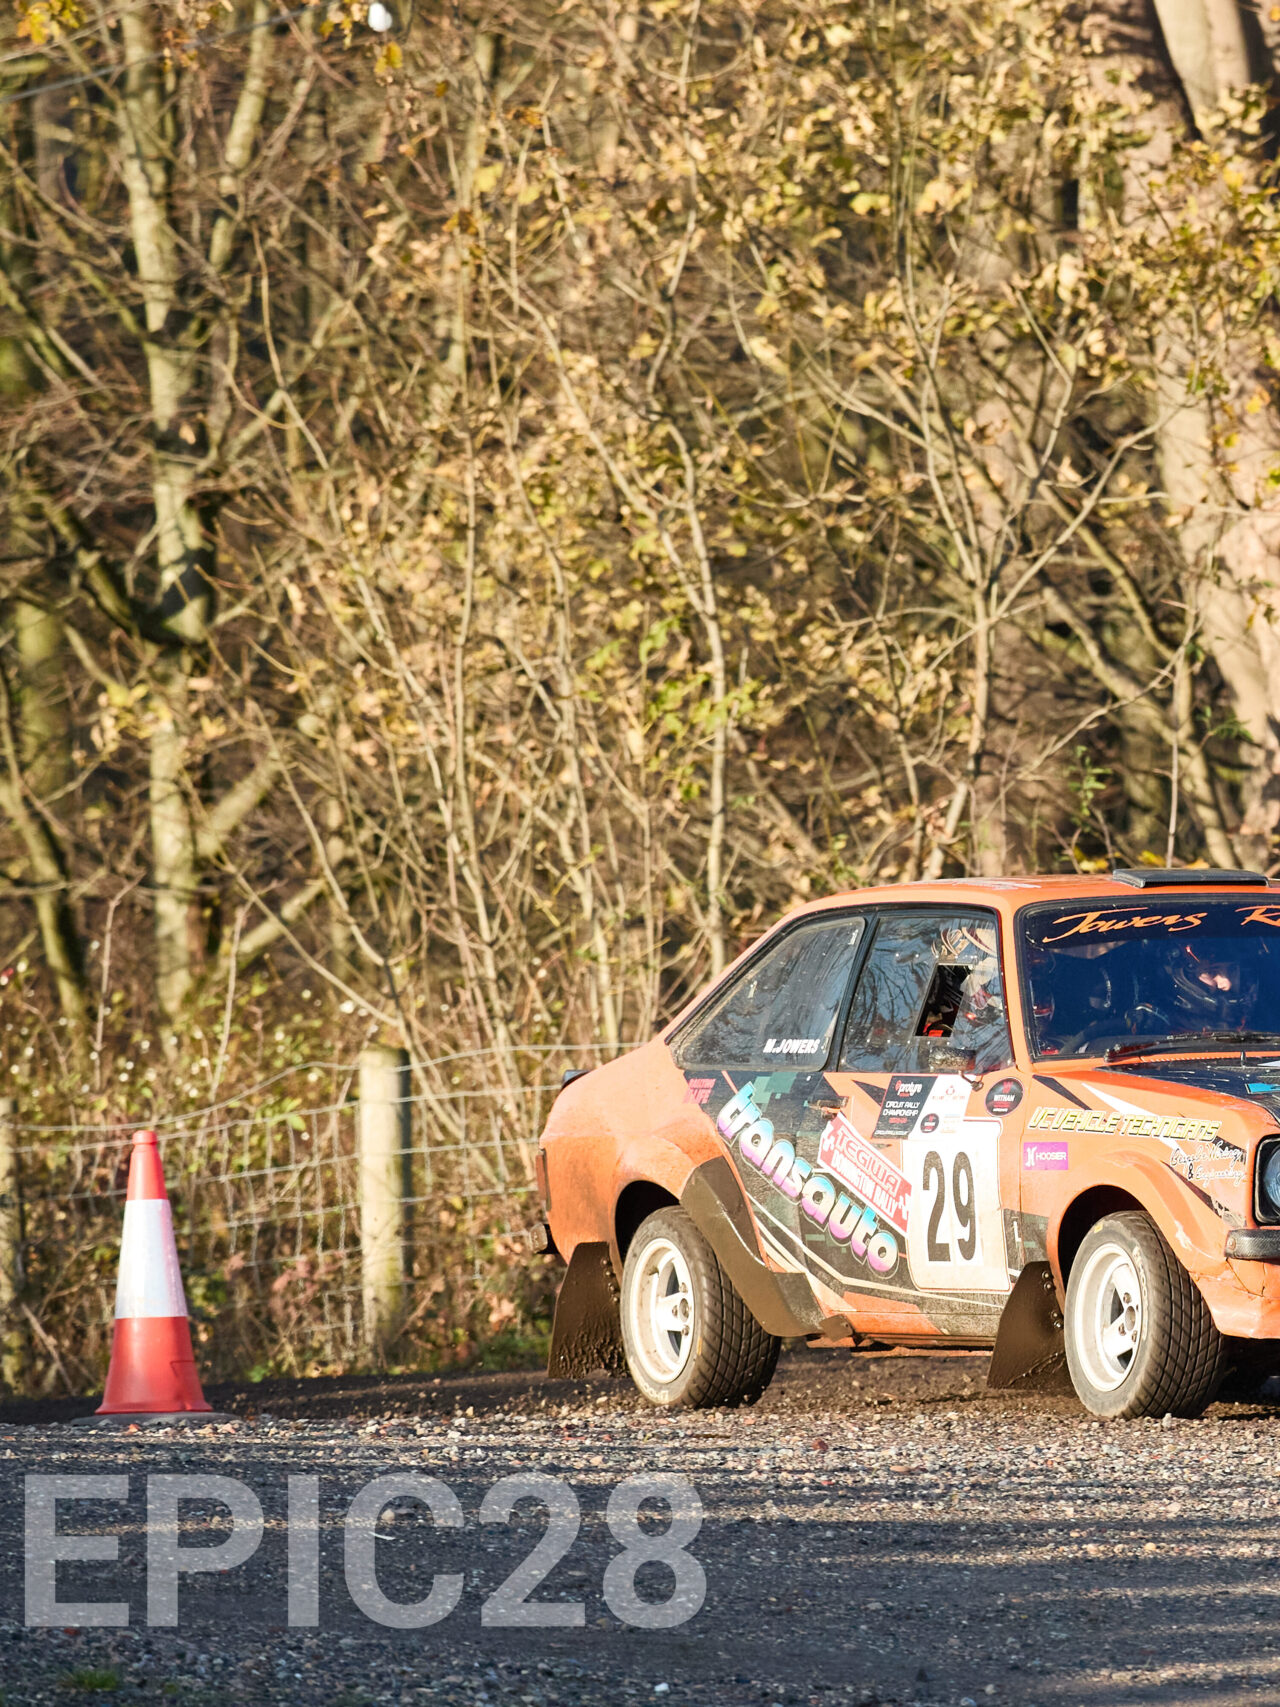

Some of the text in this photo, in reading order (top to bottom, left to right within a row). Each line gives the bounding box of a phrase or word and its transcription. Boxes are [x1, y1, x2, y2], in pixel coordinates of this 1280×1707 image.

[763, 1038, 820, 1054] M.JOWERS
[896, 1081, 922, 1096] protyre
[882, 1108, 919, 1117] CHAMPIONSHIP
[885, 1101, 921, 1109] CIRCUIT RALLY
[1035, 1151, 1067, 1161] HOOSIER
[716, 1080, 899, 1276] transauto
[1187, 1162, 1194, 1180] &
[874, 1181, 898, 1219] RALLY
[922, 1150, 977, 1262] 29
